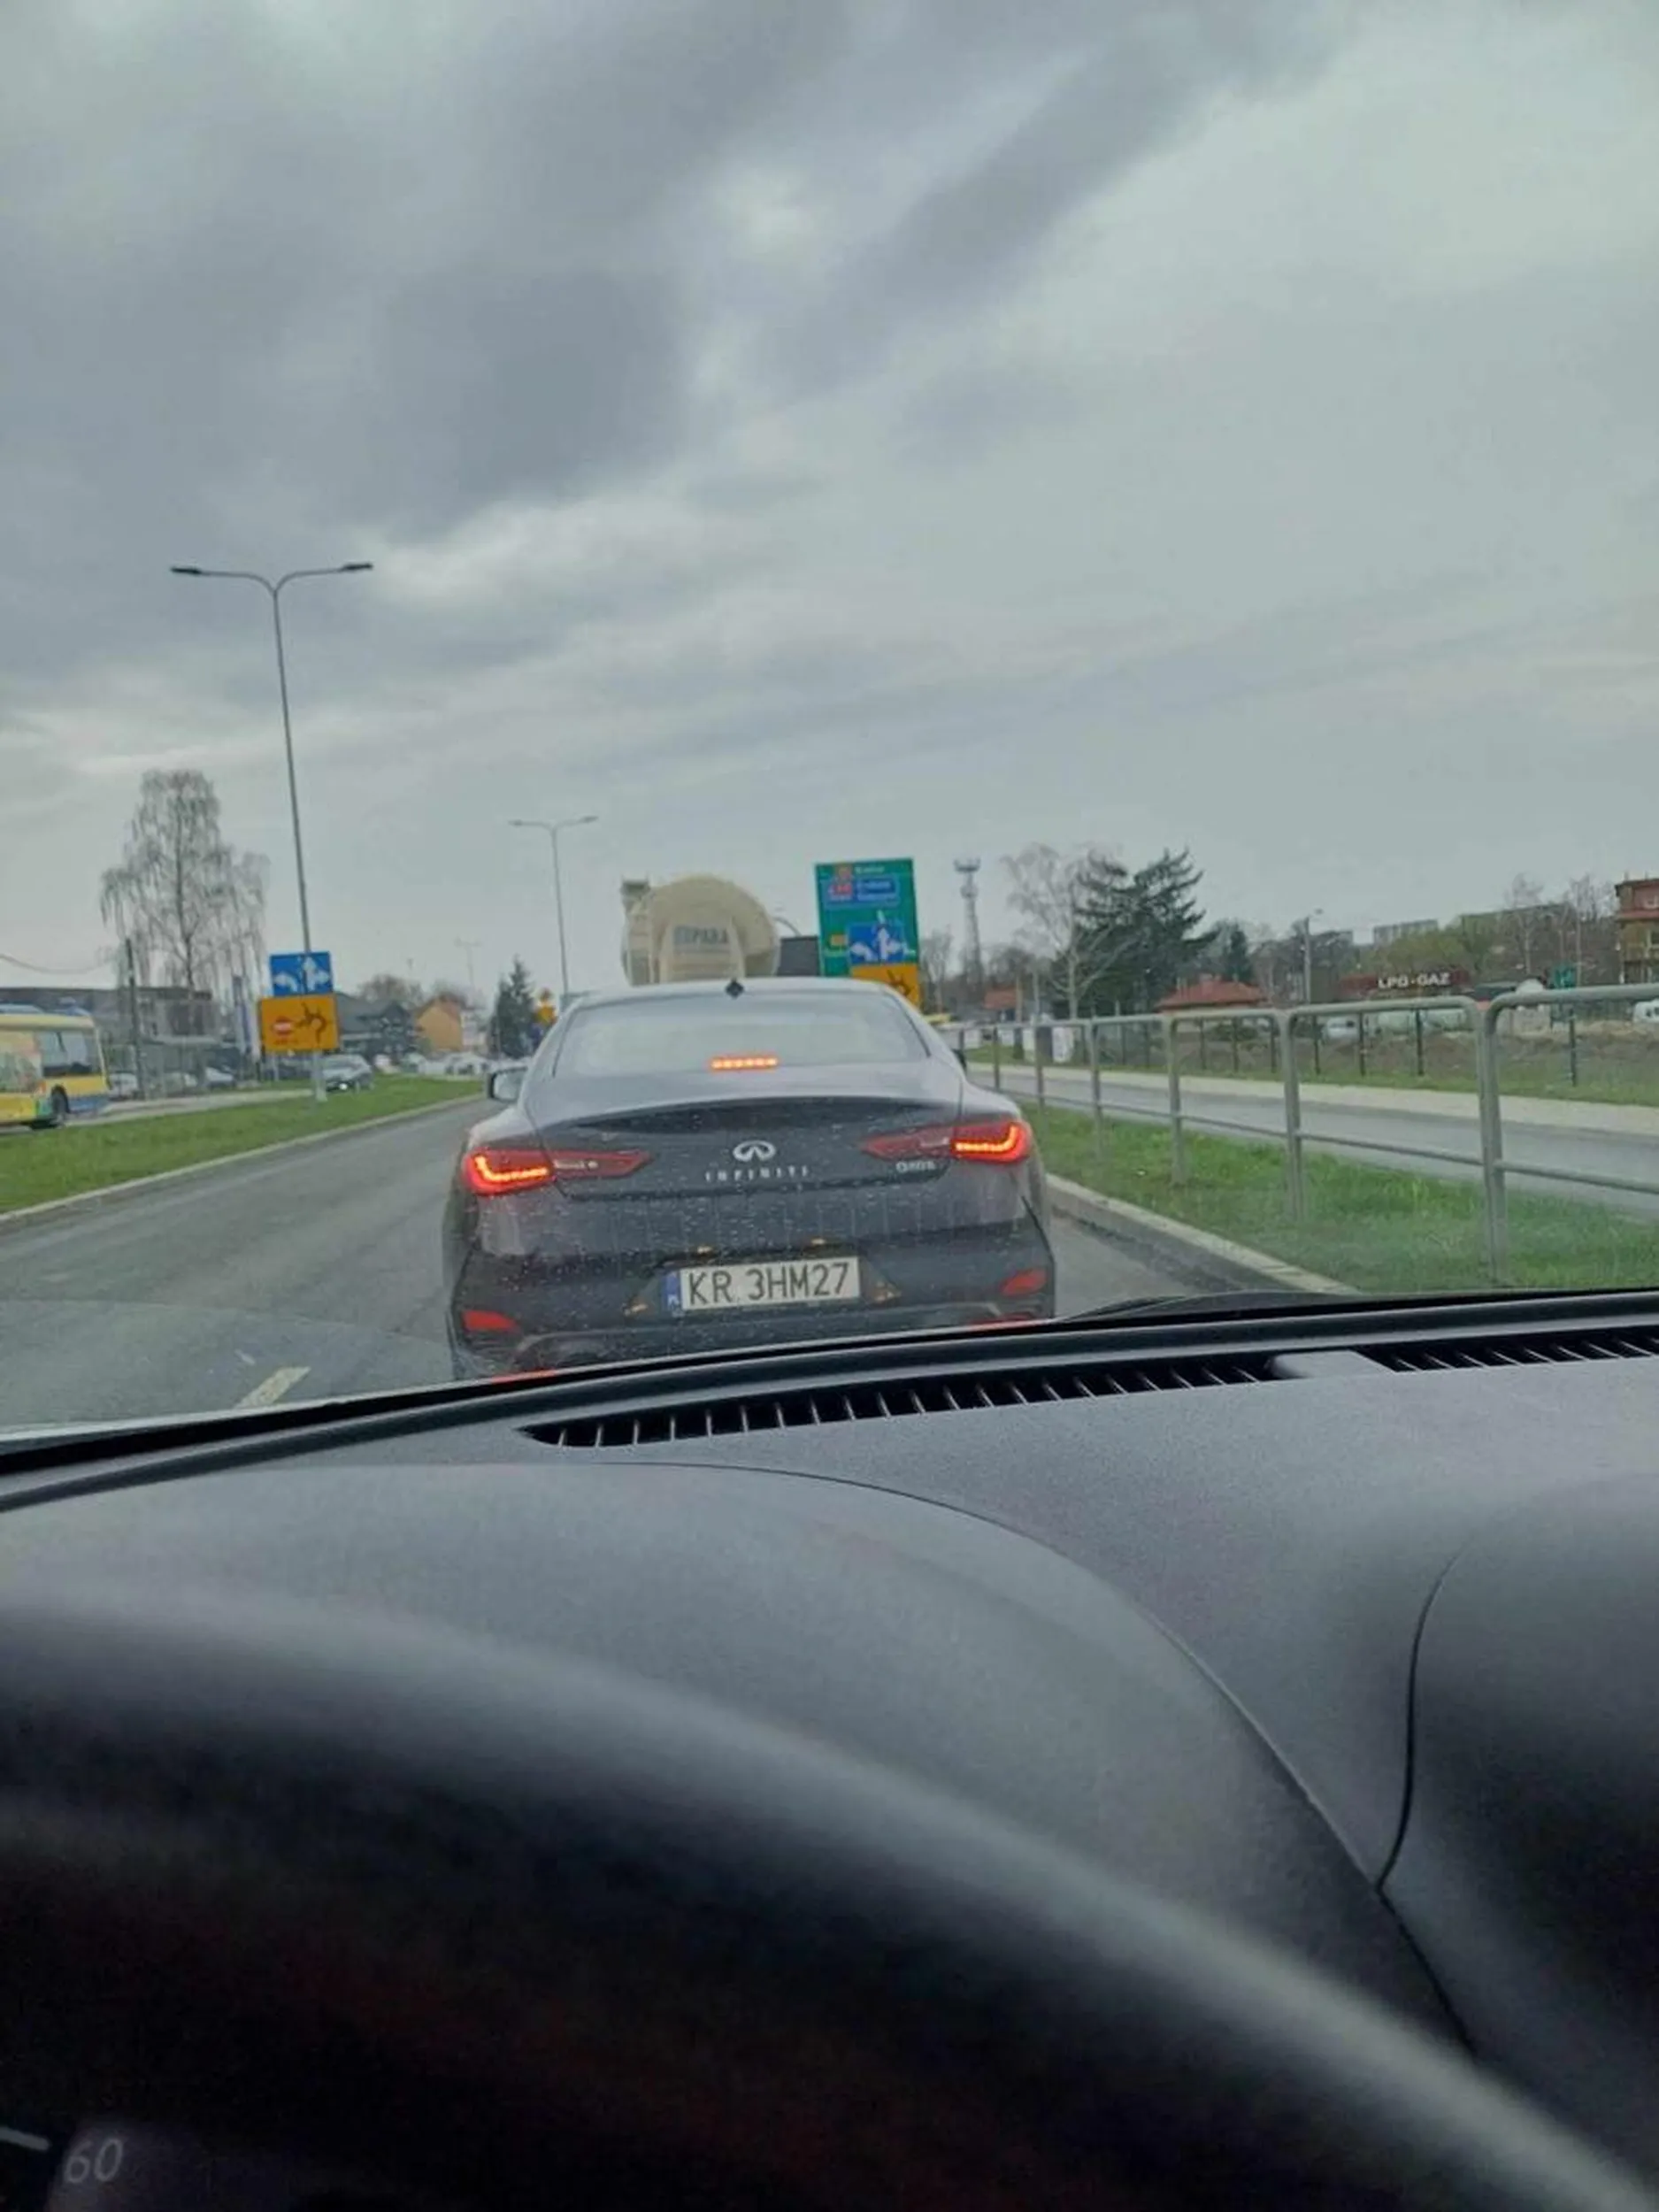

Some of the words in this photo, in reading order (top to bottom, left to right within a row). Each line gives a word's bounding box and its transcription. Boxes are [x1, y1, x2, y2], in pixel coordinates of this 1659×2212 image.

[705, 1165, 807, 1182] INFINITI
[689, 1270, 734, 1305] KR
[746, 1262, 849, 1302] 3HM27
[64, 2138, 124, 2185] 60
